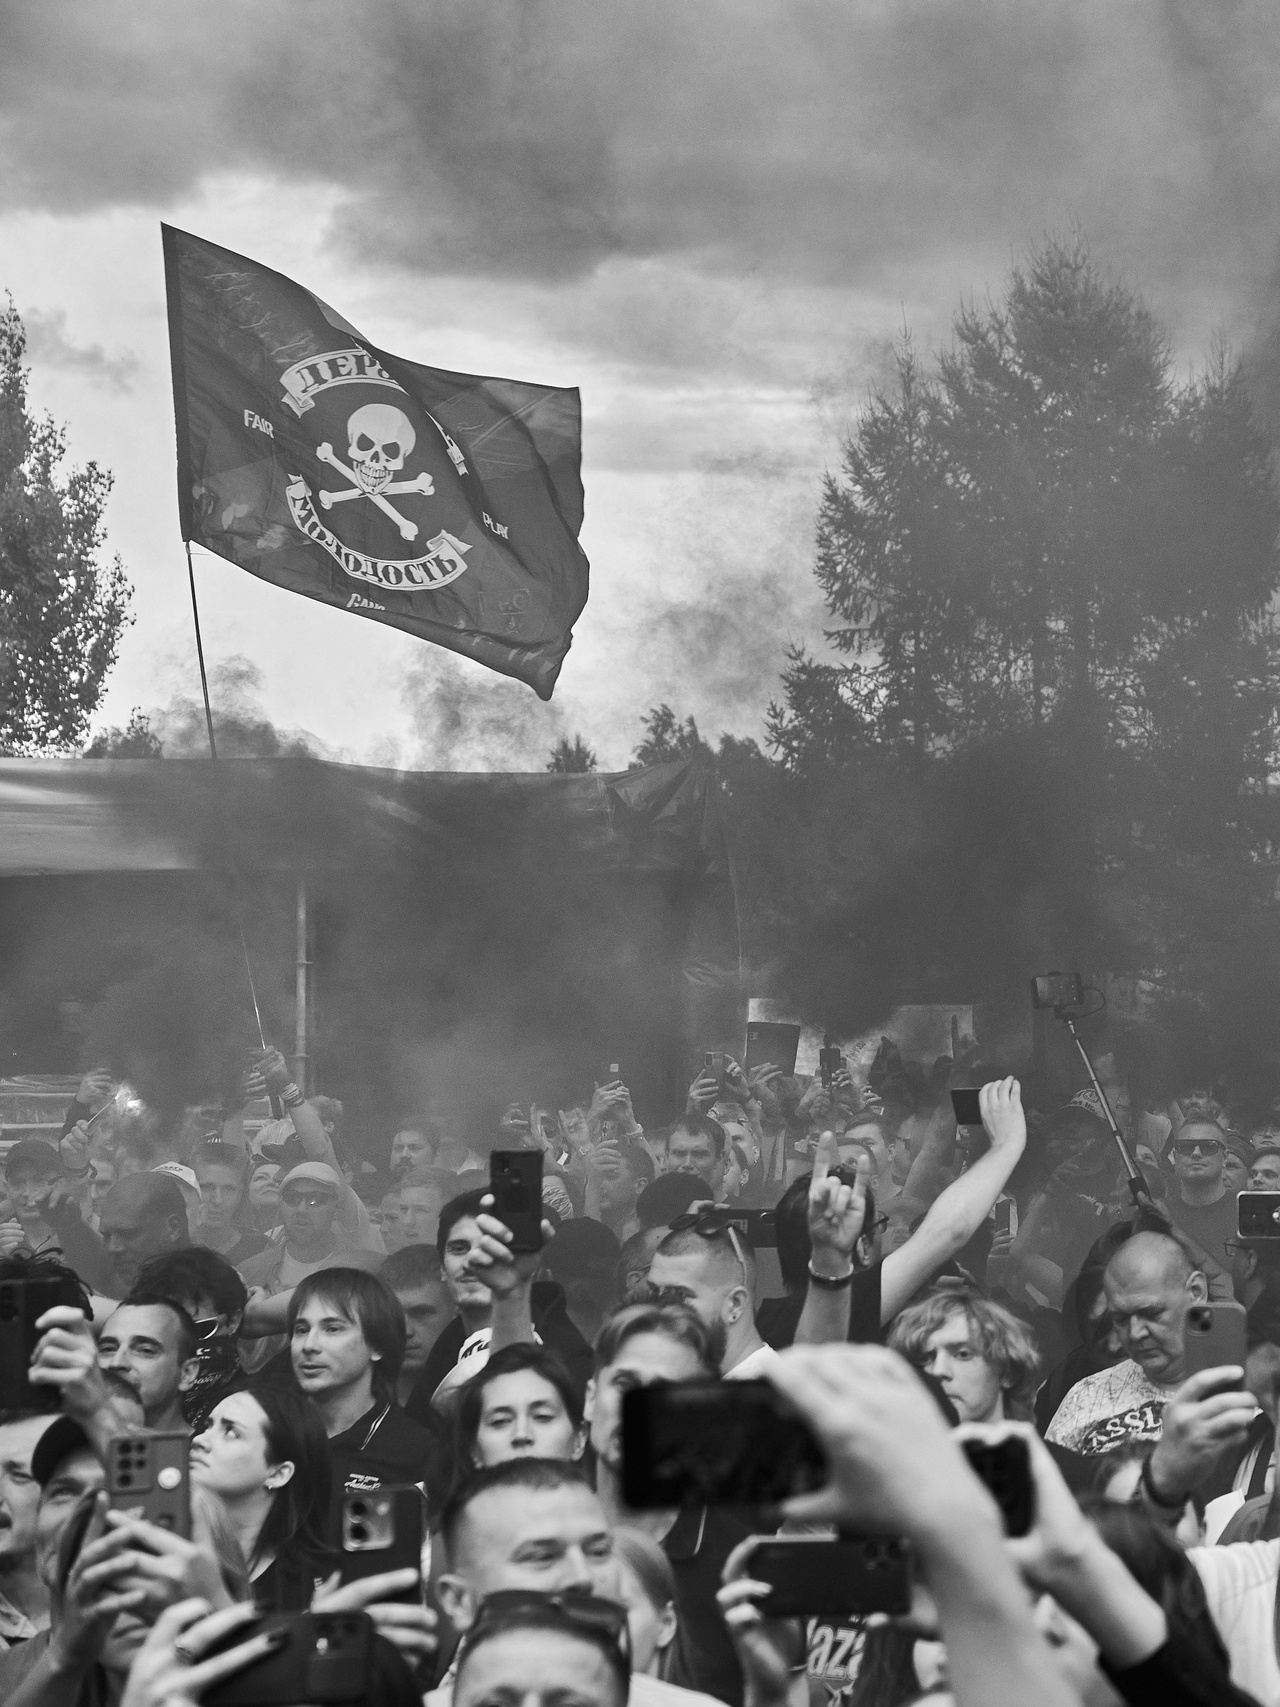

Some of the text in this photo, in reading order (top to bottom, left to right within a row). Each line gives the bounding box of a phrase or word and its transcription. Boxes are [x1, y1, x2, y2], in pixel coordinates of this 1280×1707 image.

[244, 409, 275, 439] FAIR
[482, 511, 509, 540] PLAY
[292, 498, 458, 585] МОЛОДОСТЬ
